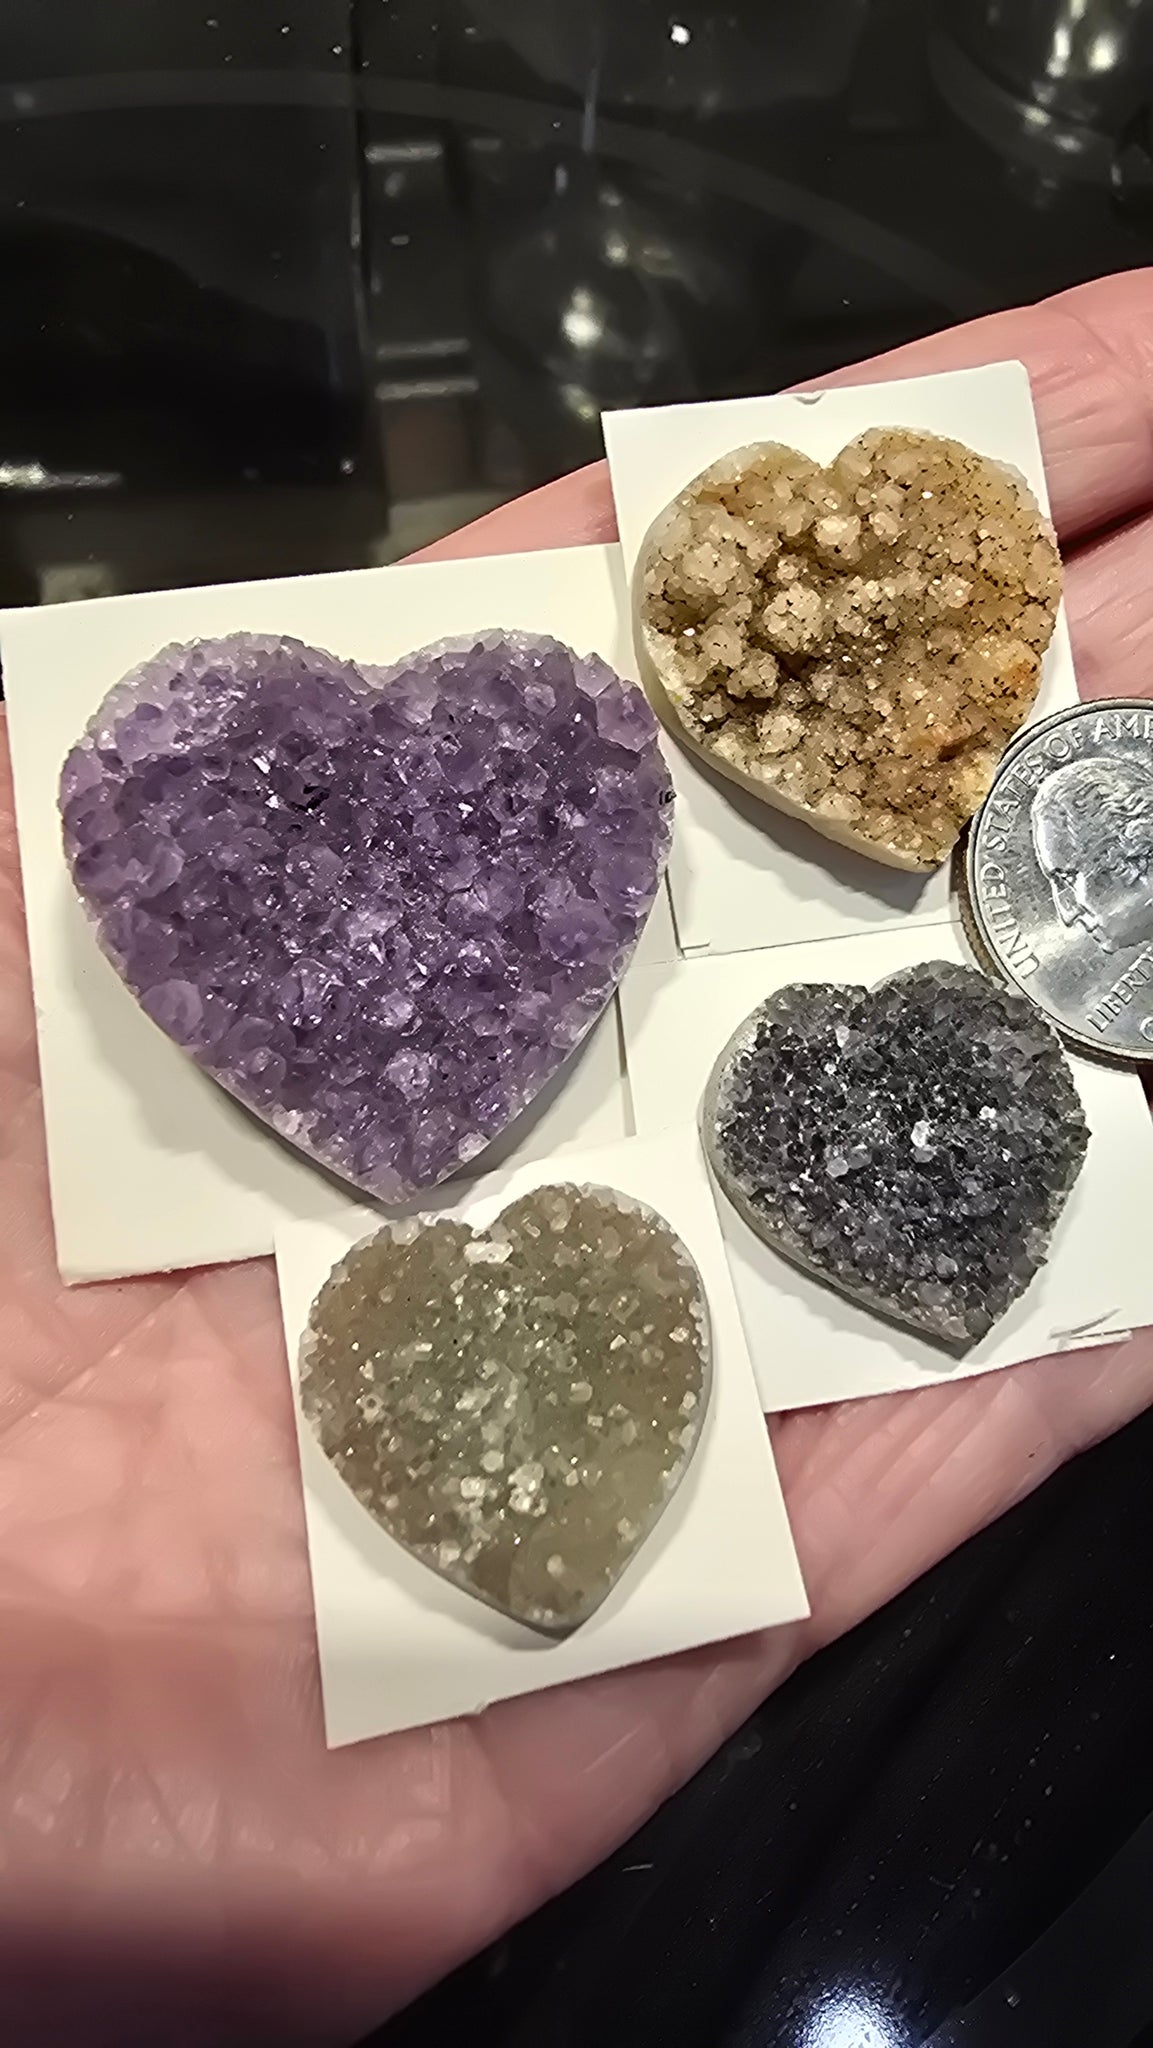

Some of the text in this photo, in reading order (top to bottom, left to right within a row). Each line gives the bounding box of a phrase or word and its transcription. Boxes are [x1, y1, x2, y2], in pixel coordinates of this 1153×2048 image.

[1043, 722, 1082, 761] OF
[982, 752, 1046, 852] STATES
[981, 862, 1040, 980] UNITED
